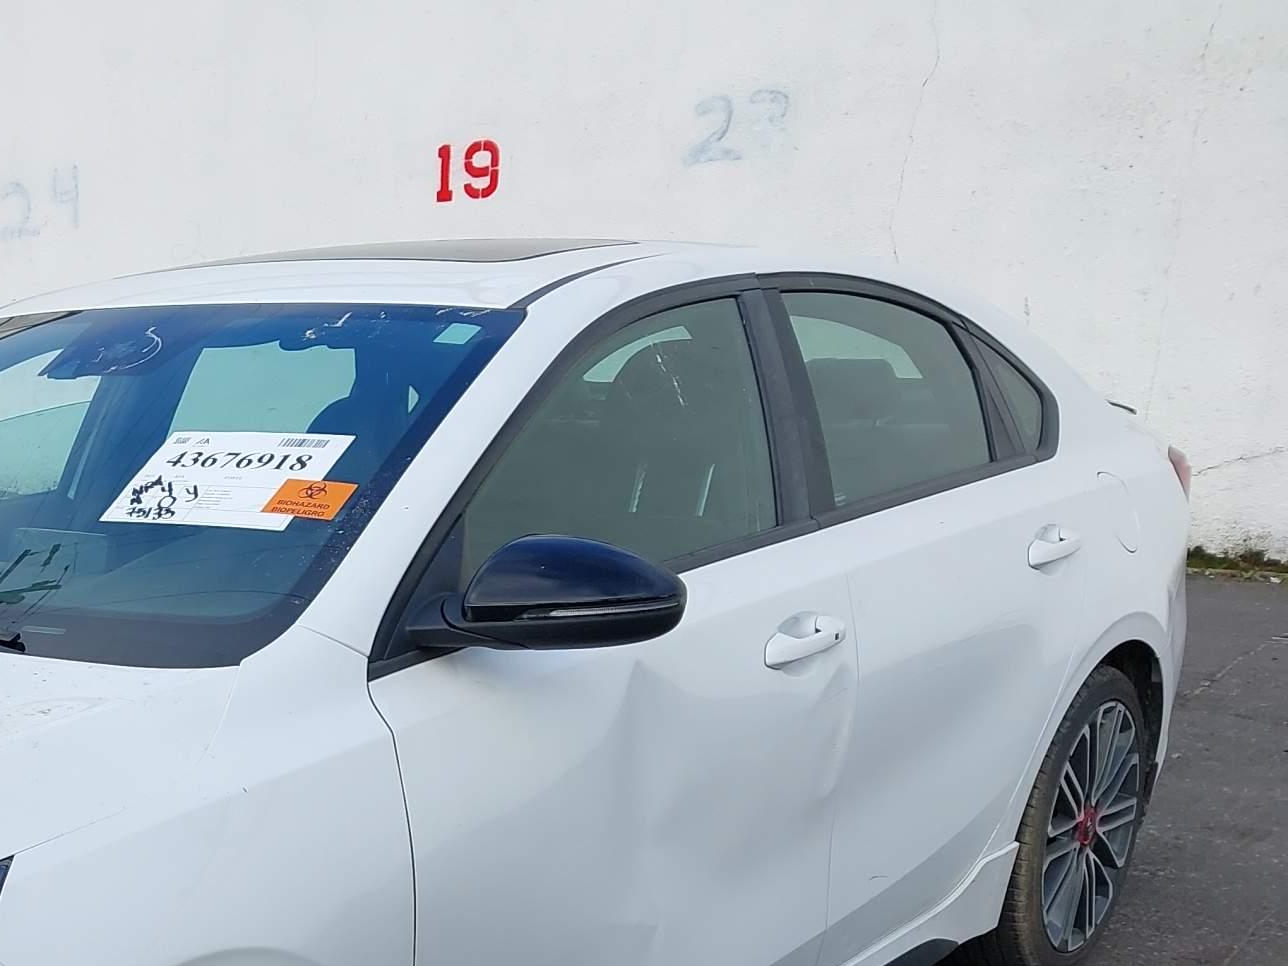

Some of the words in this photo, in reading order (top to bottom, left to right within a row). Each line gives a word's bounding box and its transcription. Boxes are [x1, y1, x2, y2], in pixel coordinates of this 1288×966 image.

[435, 139, 501, 202] 19
[166, 451, 313, 472] 43676918
[272, 507, 326, 517] BIOPELIGRO
[276, 500, 331, 510] BIOHAZARD
